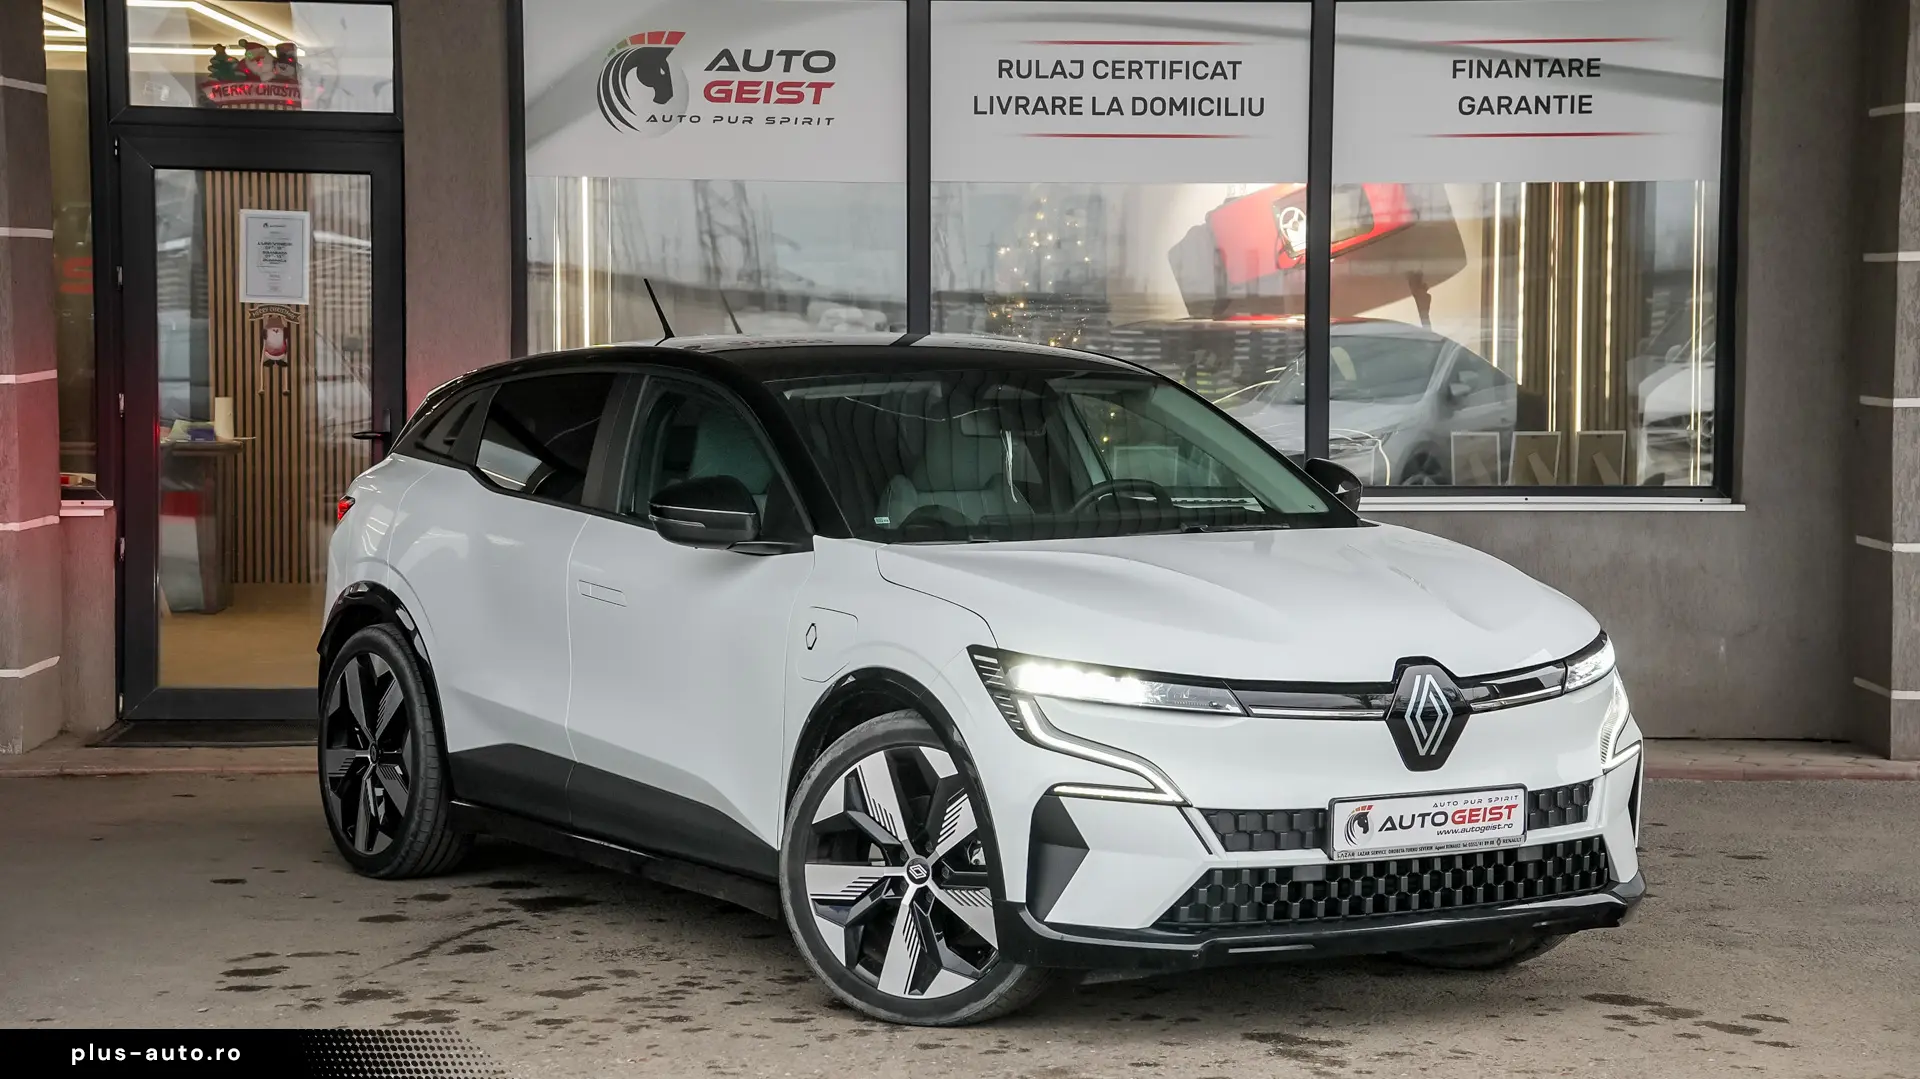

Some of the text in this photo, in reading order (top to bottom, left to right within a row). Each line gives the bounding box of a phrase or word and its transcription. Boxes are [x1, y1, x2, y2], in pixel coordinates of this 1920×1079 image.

[704, 48, 837, 74] AUTO
[998, 59, 1243, 80] RULAJ CERTIFICAT
[1452, 58, 1601, 79] FINANTARE
[211, 84, 252, 98] MERRY
[703, 80, 836, 105] GEIST
[973, 95, 1265, 117] LIVRARE LA DOMICILIU
[1458, 94, 1593, 116] GARANTIE
[646, 114, 835, 126] AUTO PUR SPIRIT
[1487, 795, 1519, 803] SPIRIT
[1436, 823, 1514, 836] www.autogeist.ro
